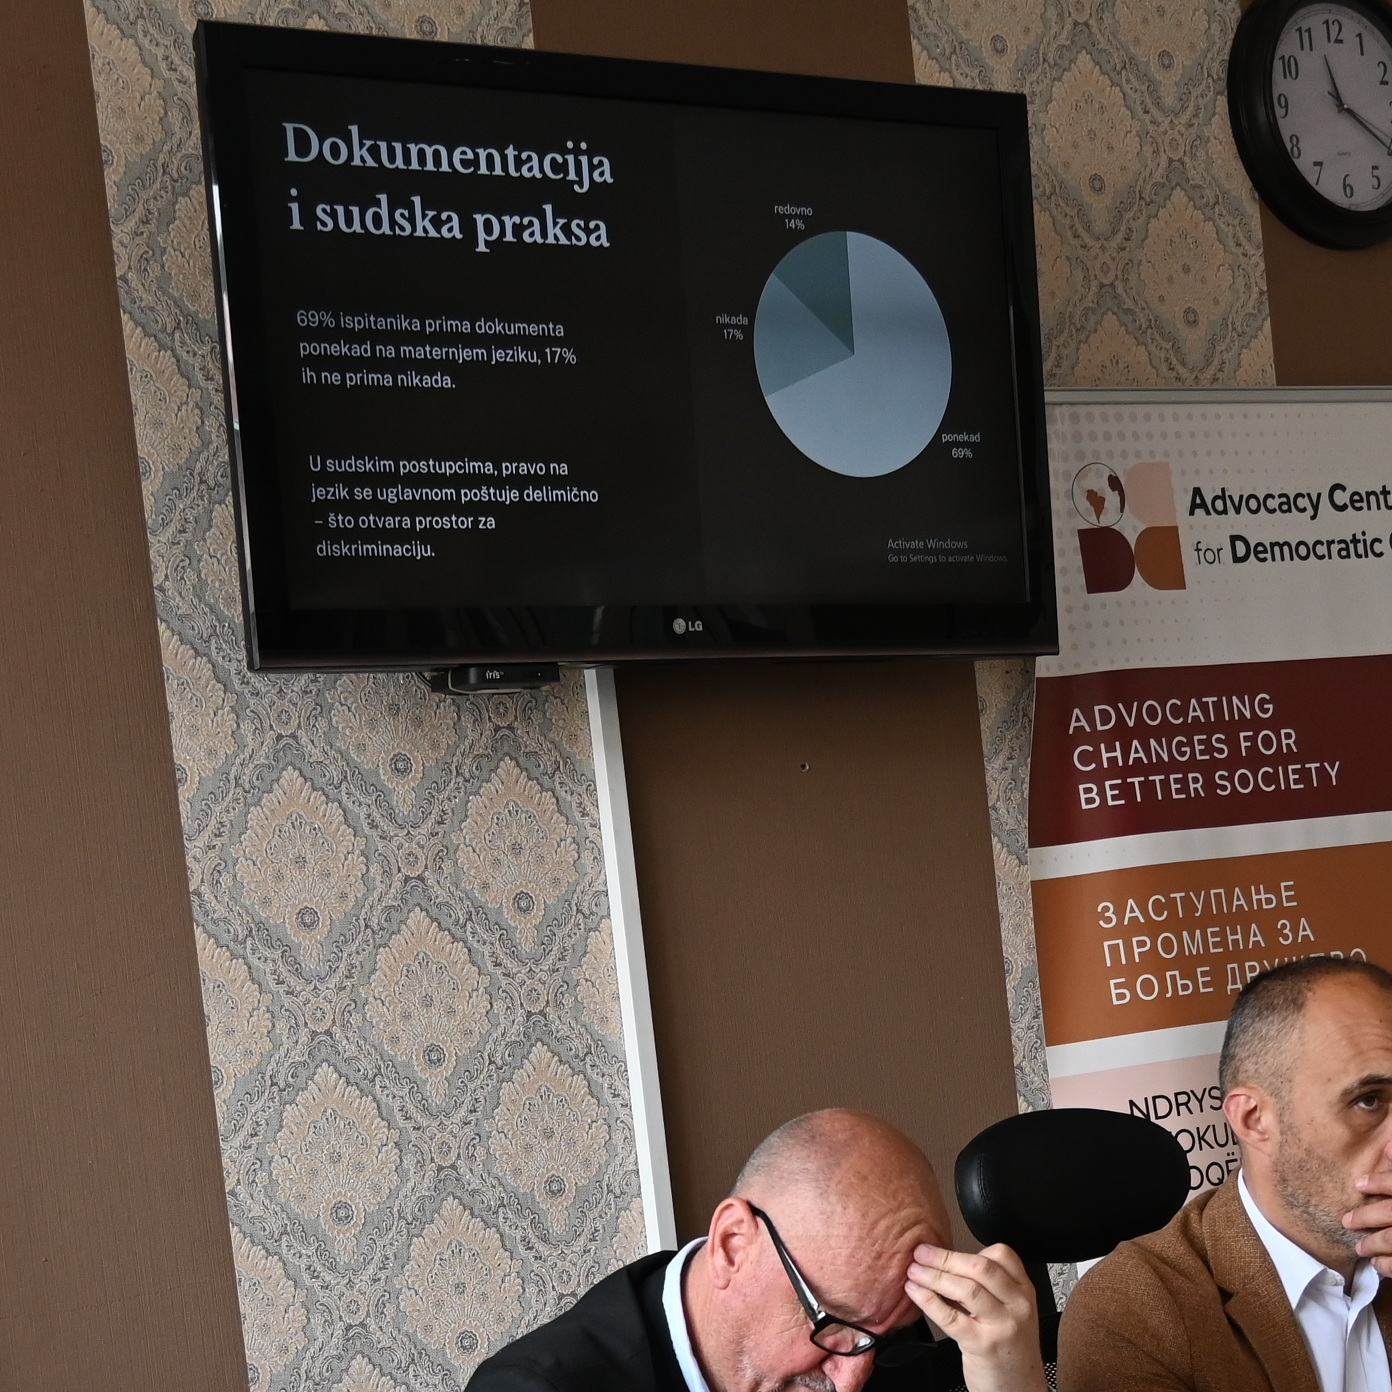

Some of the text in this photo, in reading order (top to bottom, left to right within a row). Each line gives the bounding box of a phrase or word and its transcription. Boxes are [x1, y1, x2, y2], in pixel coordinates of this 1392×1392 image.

[1295, 27, 1313, 51] 11
[1323, 19, 1343, 44] 12
[1356, 32, 1364, 56] 1
[1278, 55, 1299, 80] 10
[1378, 61, 1388, 85] 2
[1277, 93, 1288, 118] 9
[283, 123, 613, 193] Dokumentacija
[1290, 134, 1301, 159] 8
[1313, 161, 1323, 185] 7
[1372, 165, 1381, 189] 5
[1343, 174, 1354, 198] 6
[288, 188, 610, 252] i sudska praksa
[775, 204, 812, 215] redovno
[785, 219, 804, 230] 14%
[297, 310, 563, 336] 69% ispitanika prima dokumenta
[716, 314, 748, 325] nikada
[724, 329, 743, 340] 17%
[300, 340, 576, 364] ponekad na maternjem jeziku, 17%
[302, 367, 455, 388] ih ne prima nikada.
[942, 432, 980, 443] ponekad
[952, 448, 972, 458] 69%
[310, 455, 568, 477] U sudskim postupcima, pravo na
[312, 484, 598, 504] jezik se uglavnom poštuje delimično
[1189, 487, 1321, 520] Advocacy
[328, 513, 354, 528] što
[359, 514, 411, 529] otvara
[416, 514, 473, 532] prostor
[478, 516, 496, 530] za
[317, 541, 434, 559] diskriminaciju.
[888, 538, 968, 549] Activate Windows
[1194, 541, 1223, 564] for
[1229, 531, 1384, 563] Democratic
[888, 554, 898, 562] Go
[910, 554, 937, 564] Settings
[689, 621, 703, 632] LG
[1069, 694, 1273, 734] ADVOCATING
[1074, 729, 1297, 771] CHANGES FOR
[1079, 762, 1339, 809] BETTER SOCIETY
[1098, 882, 1297, 928] ЗАСТУПАЊЕ
[1103, 918, 1314, 967] ПРОМЕНА ЗА
[1109, 966, 1214, 1005] БОЉЕ
